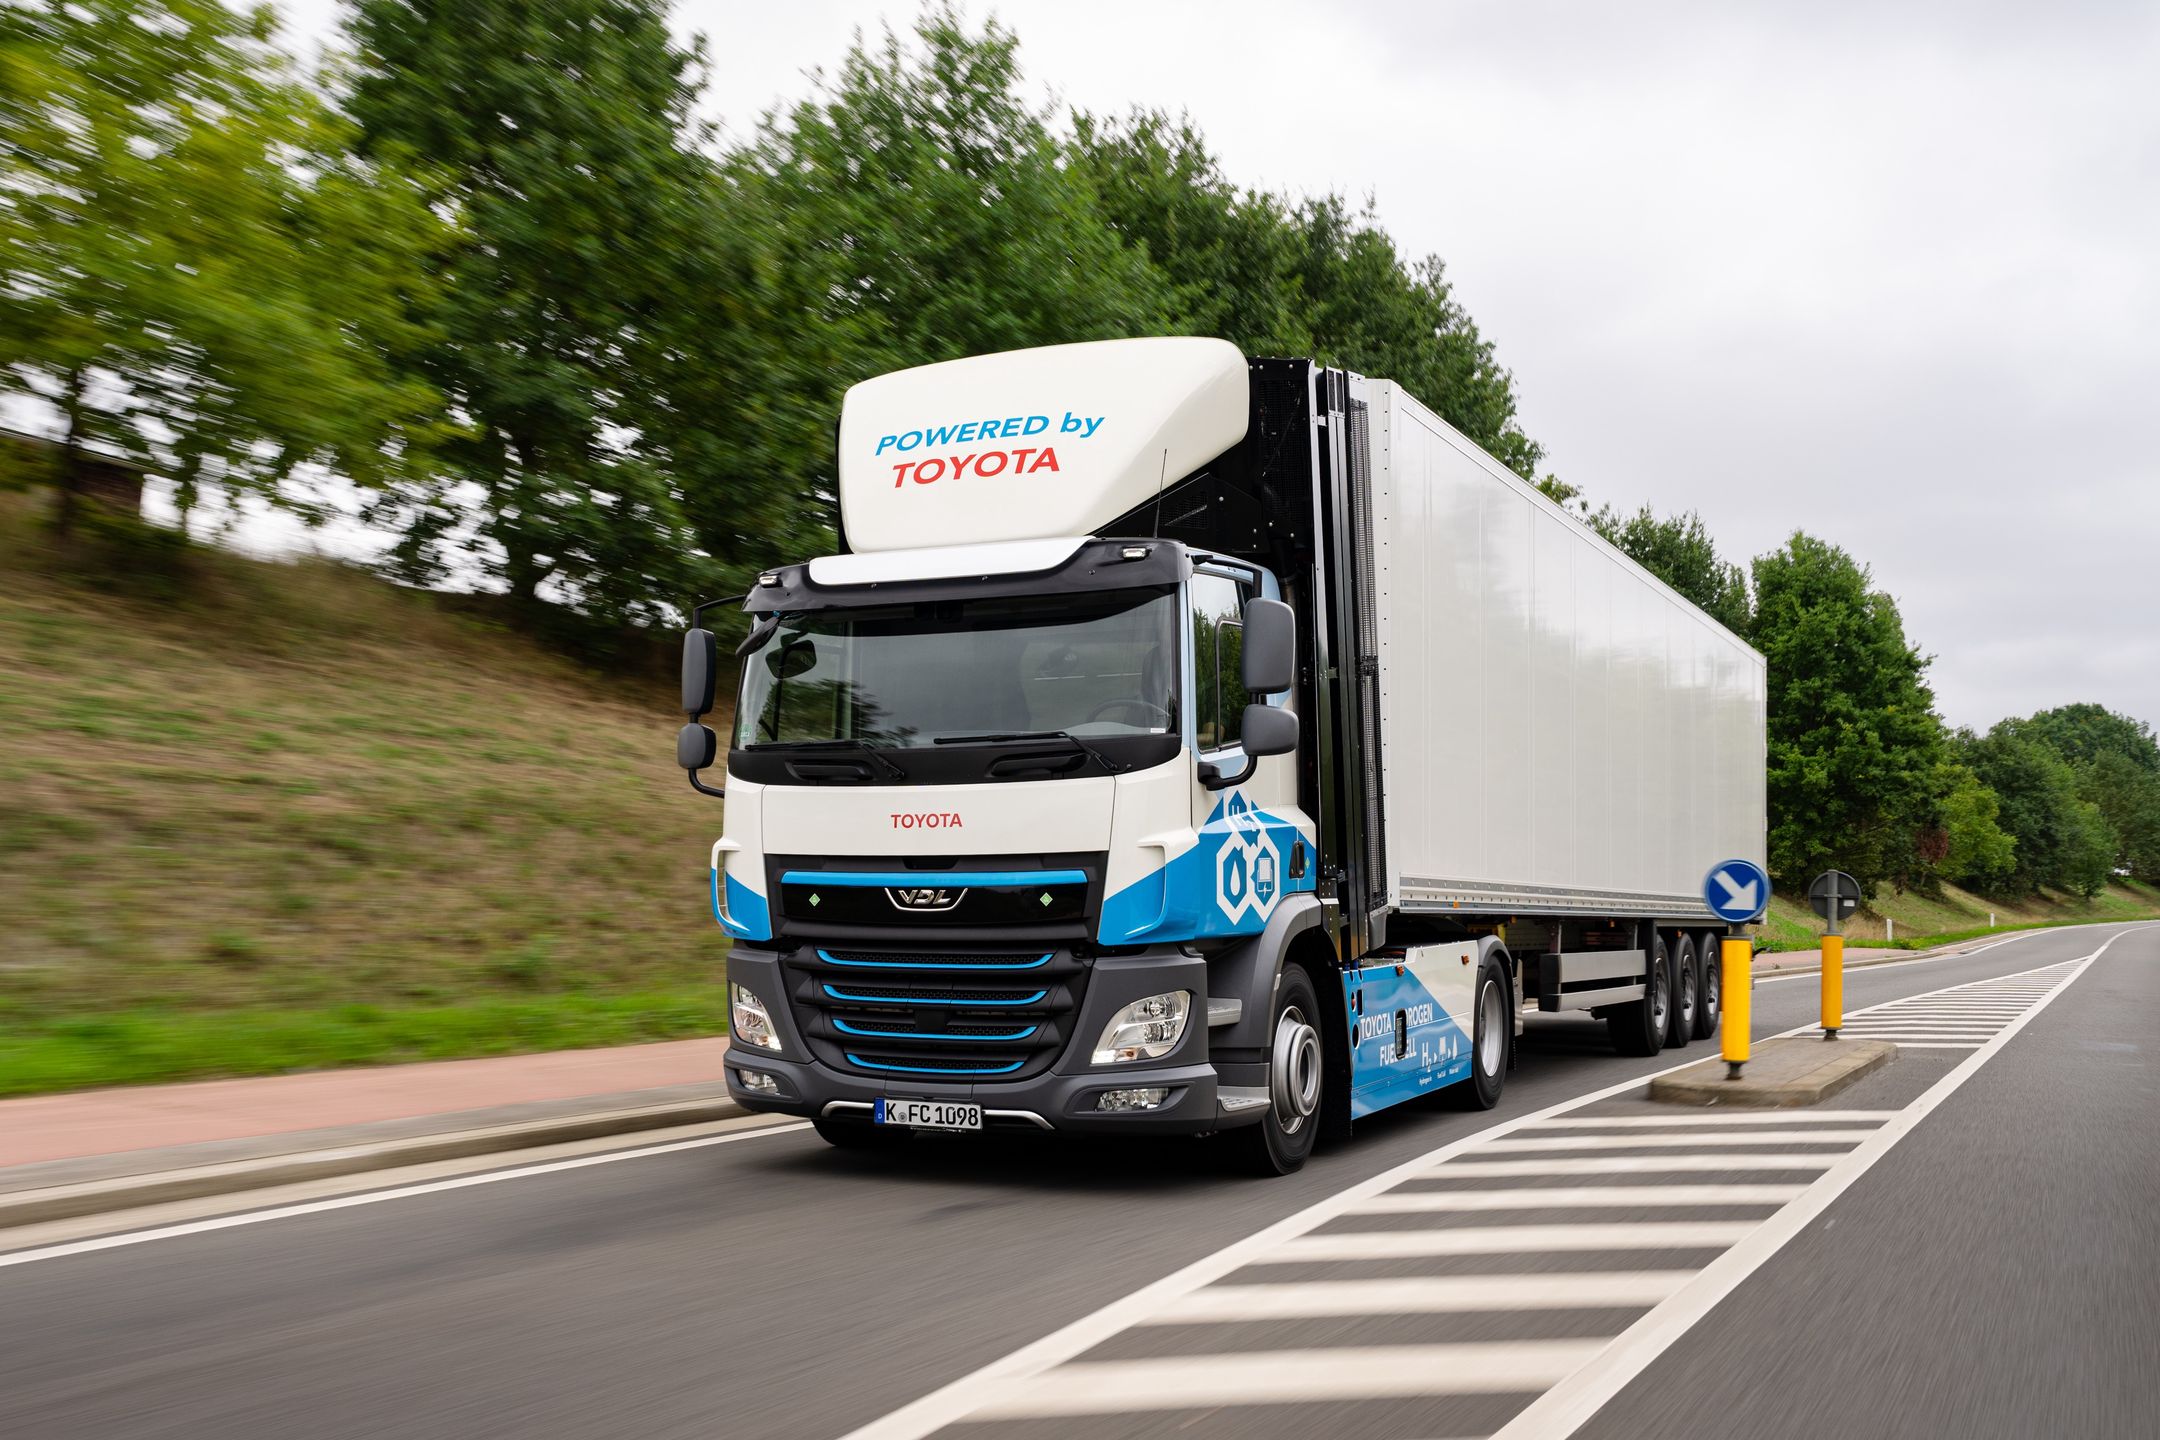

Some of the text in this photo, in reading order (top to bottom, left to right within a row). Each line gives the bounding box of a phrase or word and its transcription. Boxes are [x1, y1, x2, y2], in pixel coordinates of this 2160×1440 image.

[875, 411, 1105, 456] POWERED by
[892, 447, 1060, 488] TOYOTA
[890, 813, 963, 829] TOYOTA
[898, 889, 951, 905] VDL
[1360, 1012, 1393, 1039] TOYOTA
[886, 1102, 979, 1126] K FC 1098
